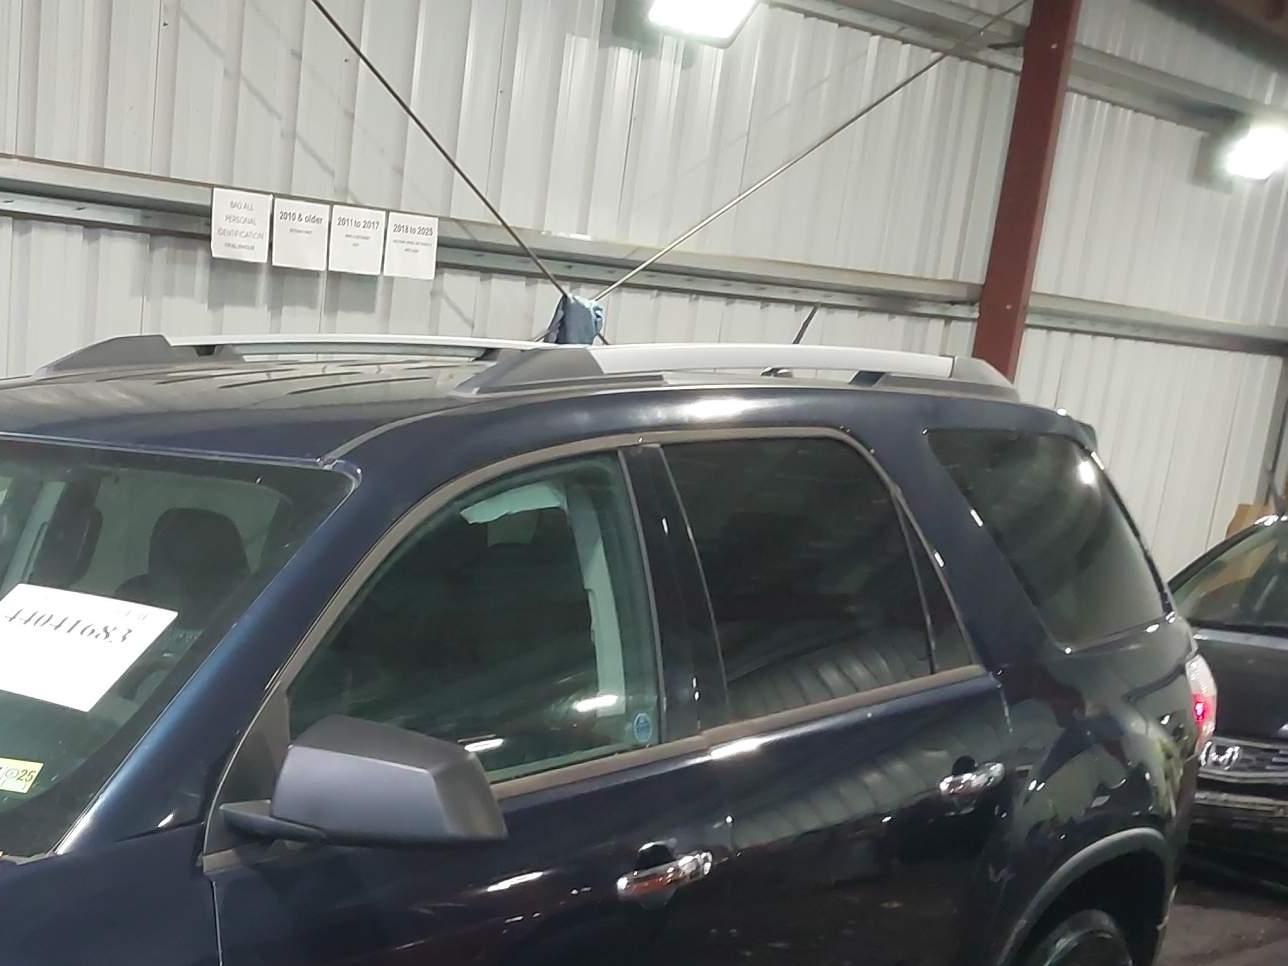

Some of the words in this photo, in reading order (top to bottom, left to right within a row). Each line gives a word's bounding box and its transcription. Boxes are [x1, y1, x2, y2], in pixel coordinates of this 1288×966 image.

[279, 211, 296, 221] 2010
[304, 214, 323, 225] older
[337, 217, 353, 227] 2011
[354, 219, 361, 228] to
[362, 221, 380, 230] 2017
[393, 223, 409, 233] 2018
[410, 226, 417, 234] to
[4, 608, 133, 643] 44041683
